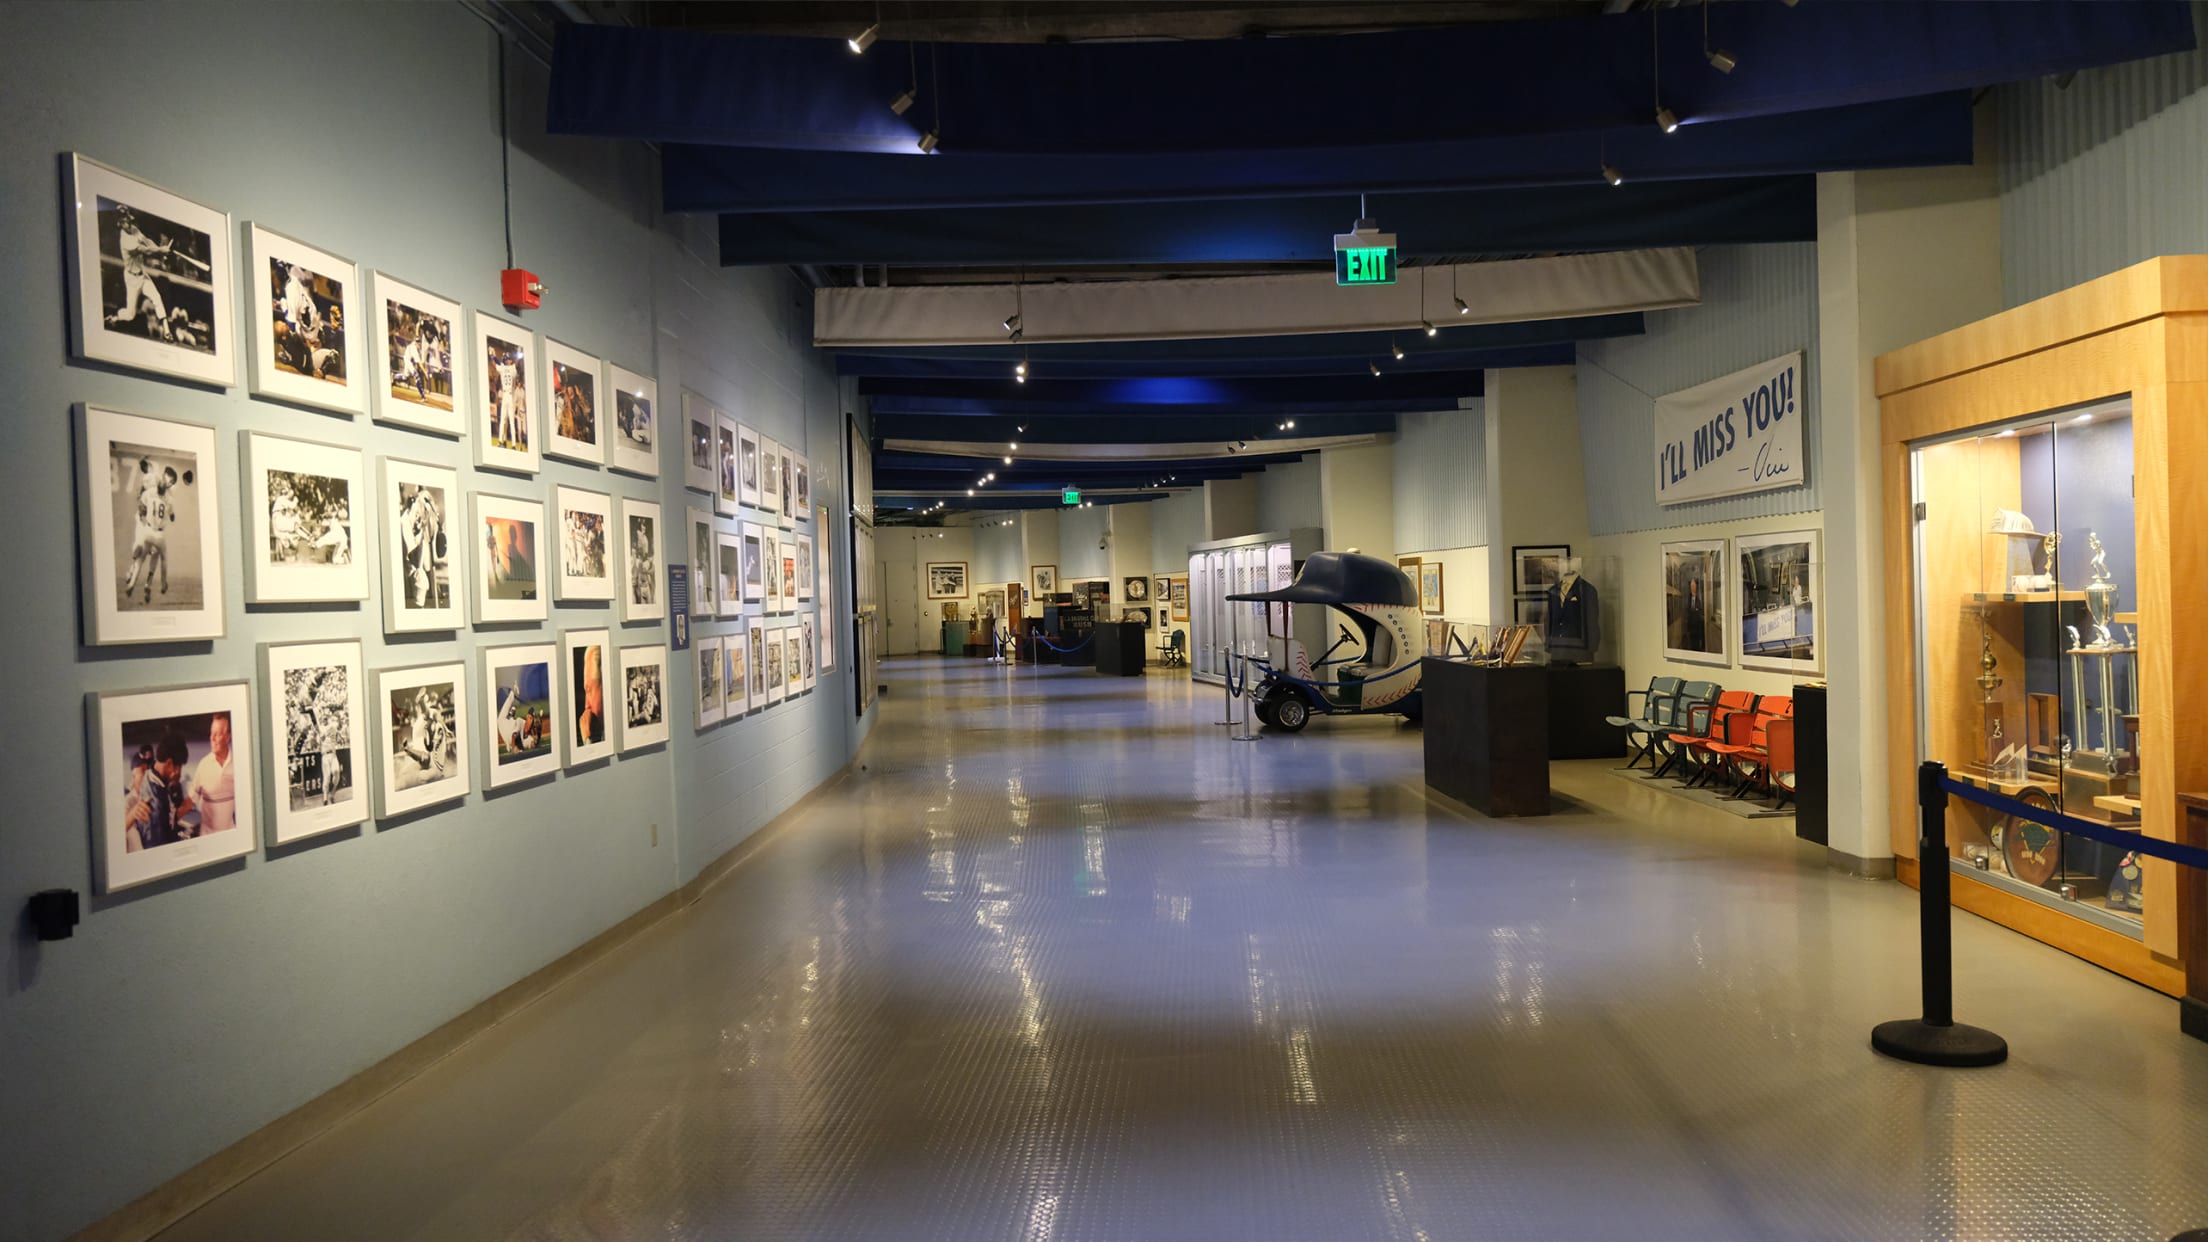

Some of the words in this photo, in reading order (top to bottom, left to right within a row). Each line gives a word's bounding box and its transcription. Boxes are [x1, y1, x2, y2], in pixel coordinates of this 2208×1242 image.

[1347, 248, 1387, 281] EXIT
[1660, 440, 1687, 491] I'LL
[1693, 407, 1736, 471] MISS
[1742, 366, 1794, 439] YOU!
[152, 501, 165, 519] 18
